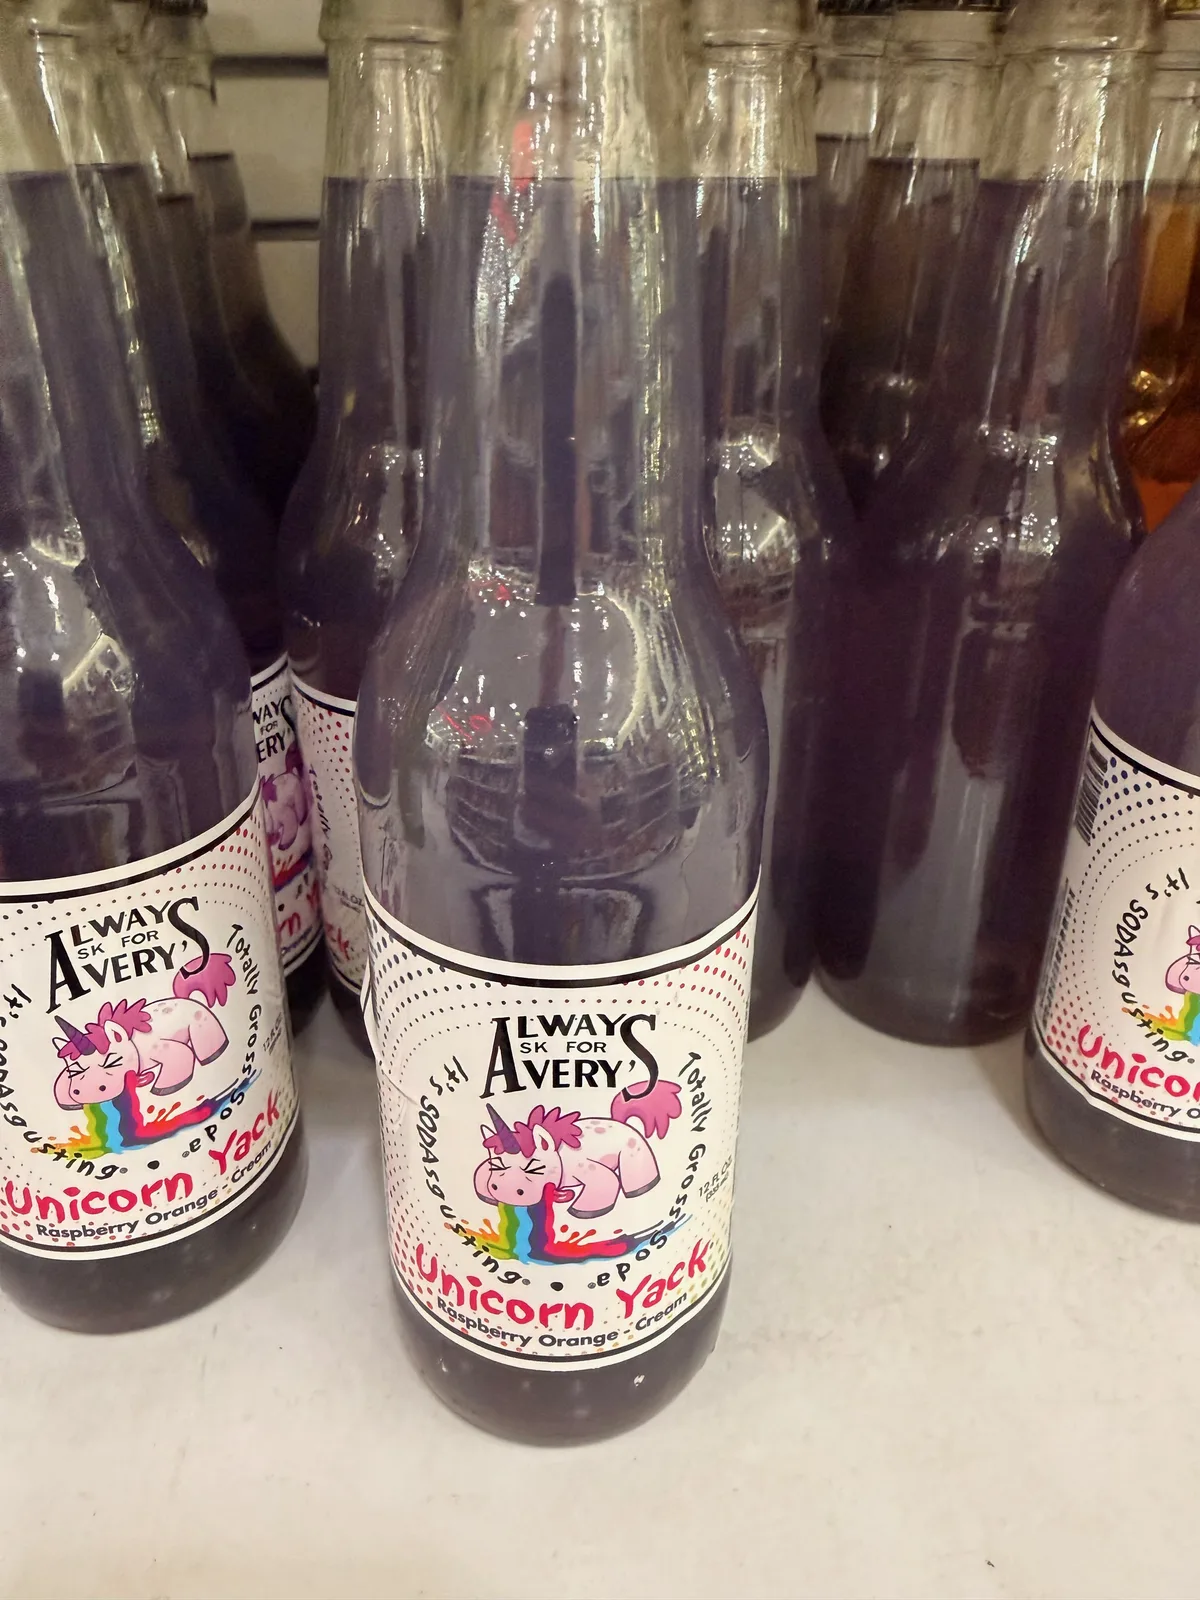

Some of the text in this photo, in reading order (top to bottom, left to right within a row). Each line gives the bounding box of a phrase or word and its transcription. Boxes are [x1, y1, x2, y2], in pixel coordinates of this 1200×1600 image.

[1146, 867, 1189, 900] It's
[121, 930, 159, 948] FOR
[226, 923, 260, 995] Totally
[242, 1003, 262, 1075] Gross
[566, 1041, 607, 1053] FOR
[1078, 1024, 1200, 1102] Unico
[429, 1055, 469, 1096] It's
[678, 1051, 713, 1133] Totally
[1091, 1069, 1182, 1118] Raspberry
[5, 1089, 280, 1224] Unicorn Yack
[36, 1219, 140, 1241] Raspberry
[145, 1187, 219, 1225] Orange
[231, 1139, 272, 1184] Cream
[668, 1143, 707, 1220] Gross
[416, 1239, 711, 1330] Unicorn Yack
[436, 1295, 533, 1347] Raspberry
[538, 1330, 618, 1348] Orange
[635, 1293, 688, 1332] Cream
